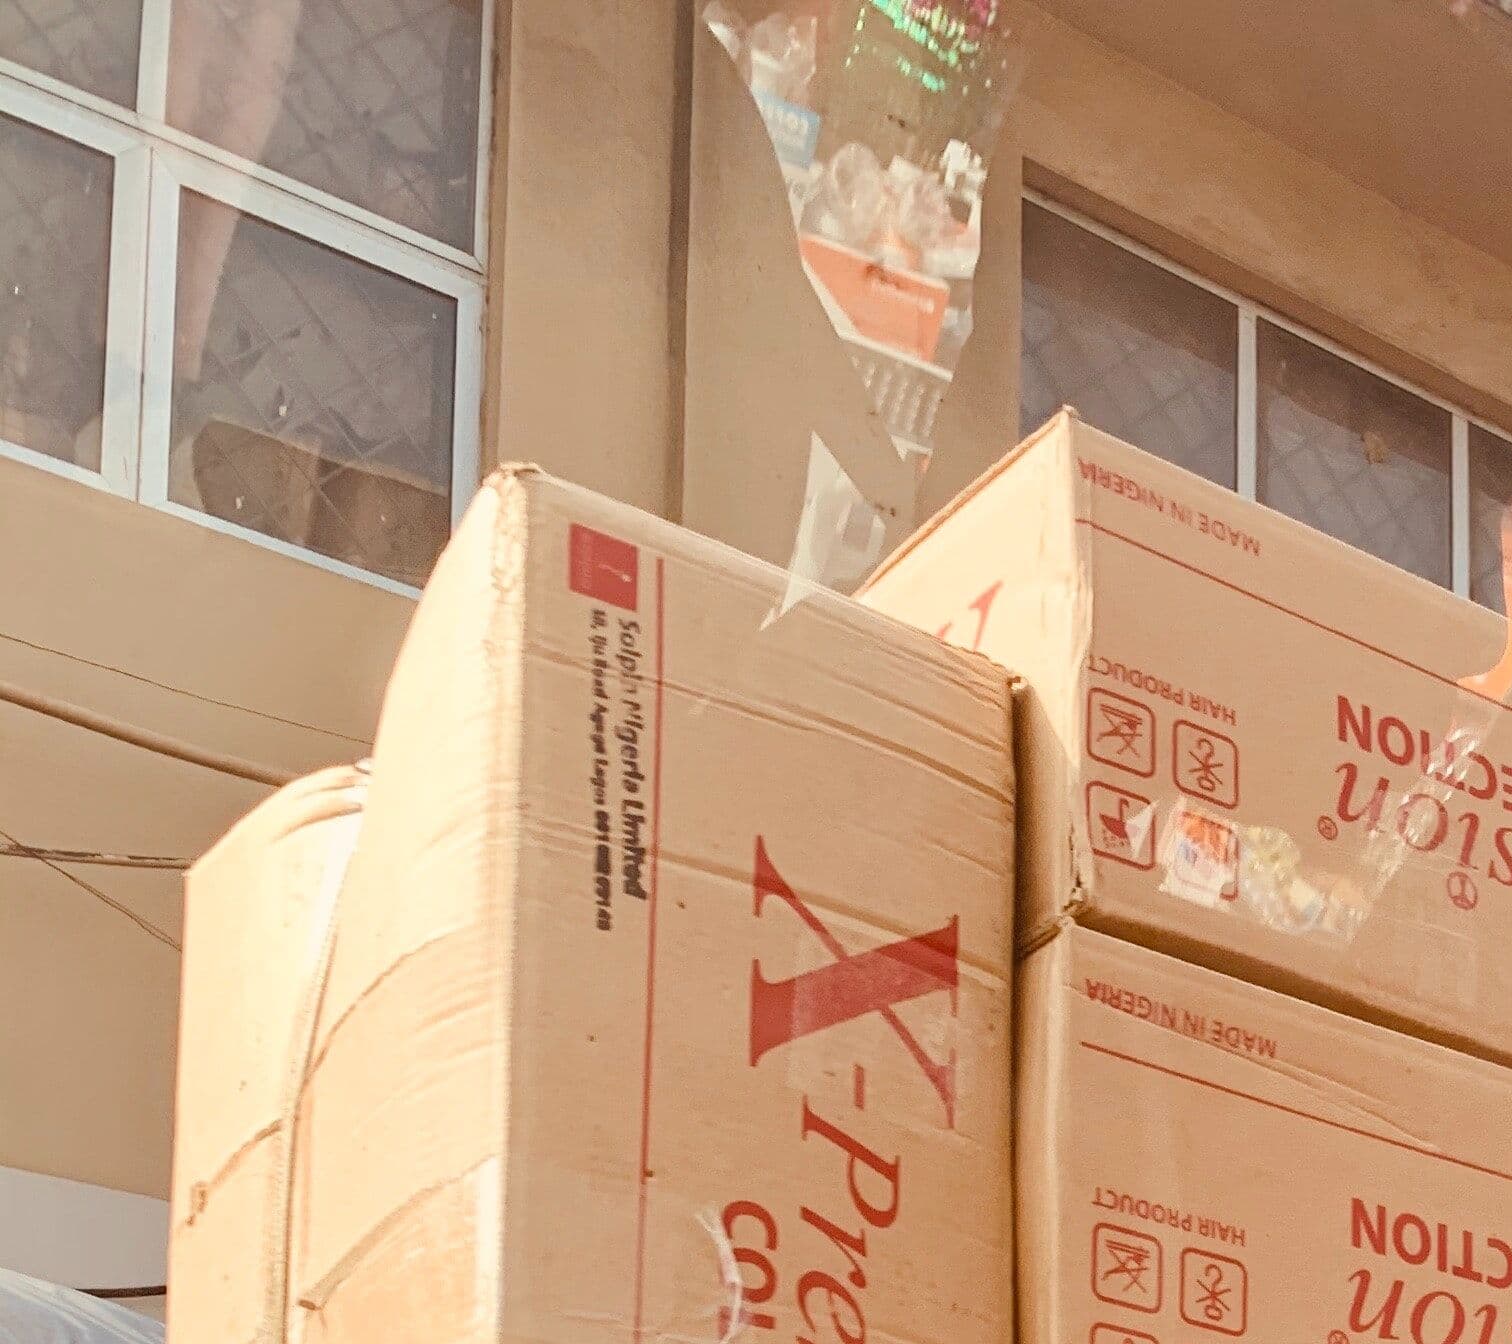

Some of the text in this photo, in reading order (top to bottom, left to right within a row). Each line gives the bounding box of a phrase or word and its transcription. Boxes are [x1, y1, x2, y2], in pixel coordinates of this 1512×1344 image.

[1198, 512, 1261, 557] MADE
[1088, 653, 1238, 727] HAIR PRODUCT
[1084, 978, 1277, 1059] MADE IN NIGERIA
[1091, 1186, 1247, 1248] HAIR PRODUCT
